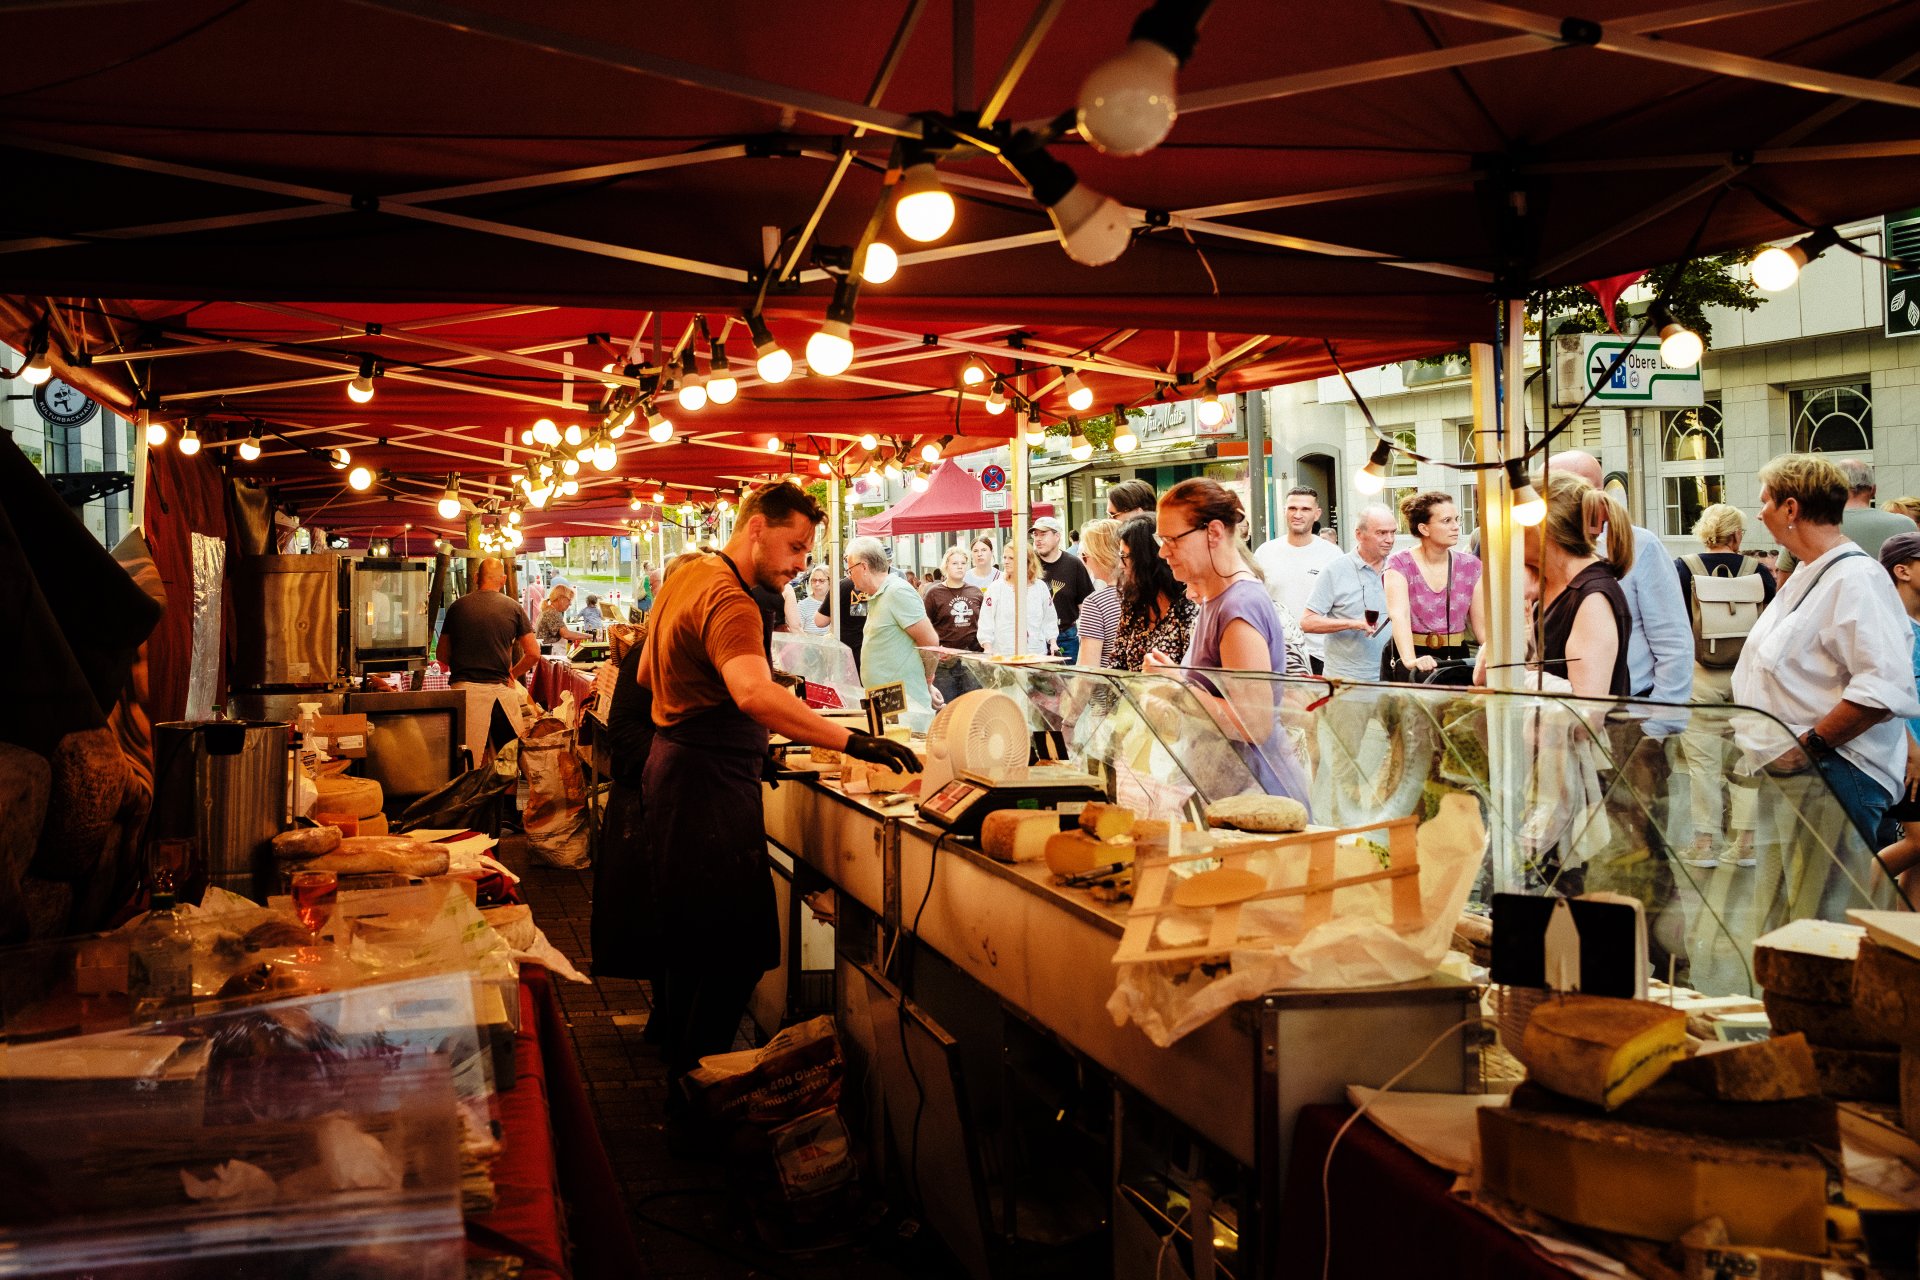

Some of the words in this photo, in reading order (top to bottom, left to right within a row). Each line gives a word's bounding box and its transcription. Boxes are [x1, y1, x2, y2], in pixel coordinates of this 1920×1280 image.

[1628, 354, 1656, 369] Obere
[1157, 403, 1185, 433] Nails
[1632, 428, 1641, 436] 71
[749, 1078, 829, 1113] Gemüsesorten
[751, 1087, 768, 1100] als
[770, 1077, 793, 1092] 400
[791, 1160, 849, 1183] Kaufland
